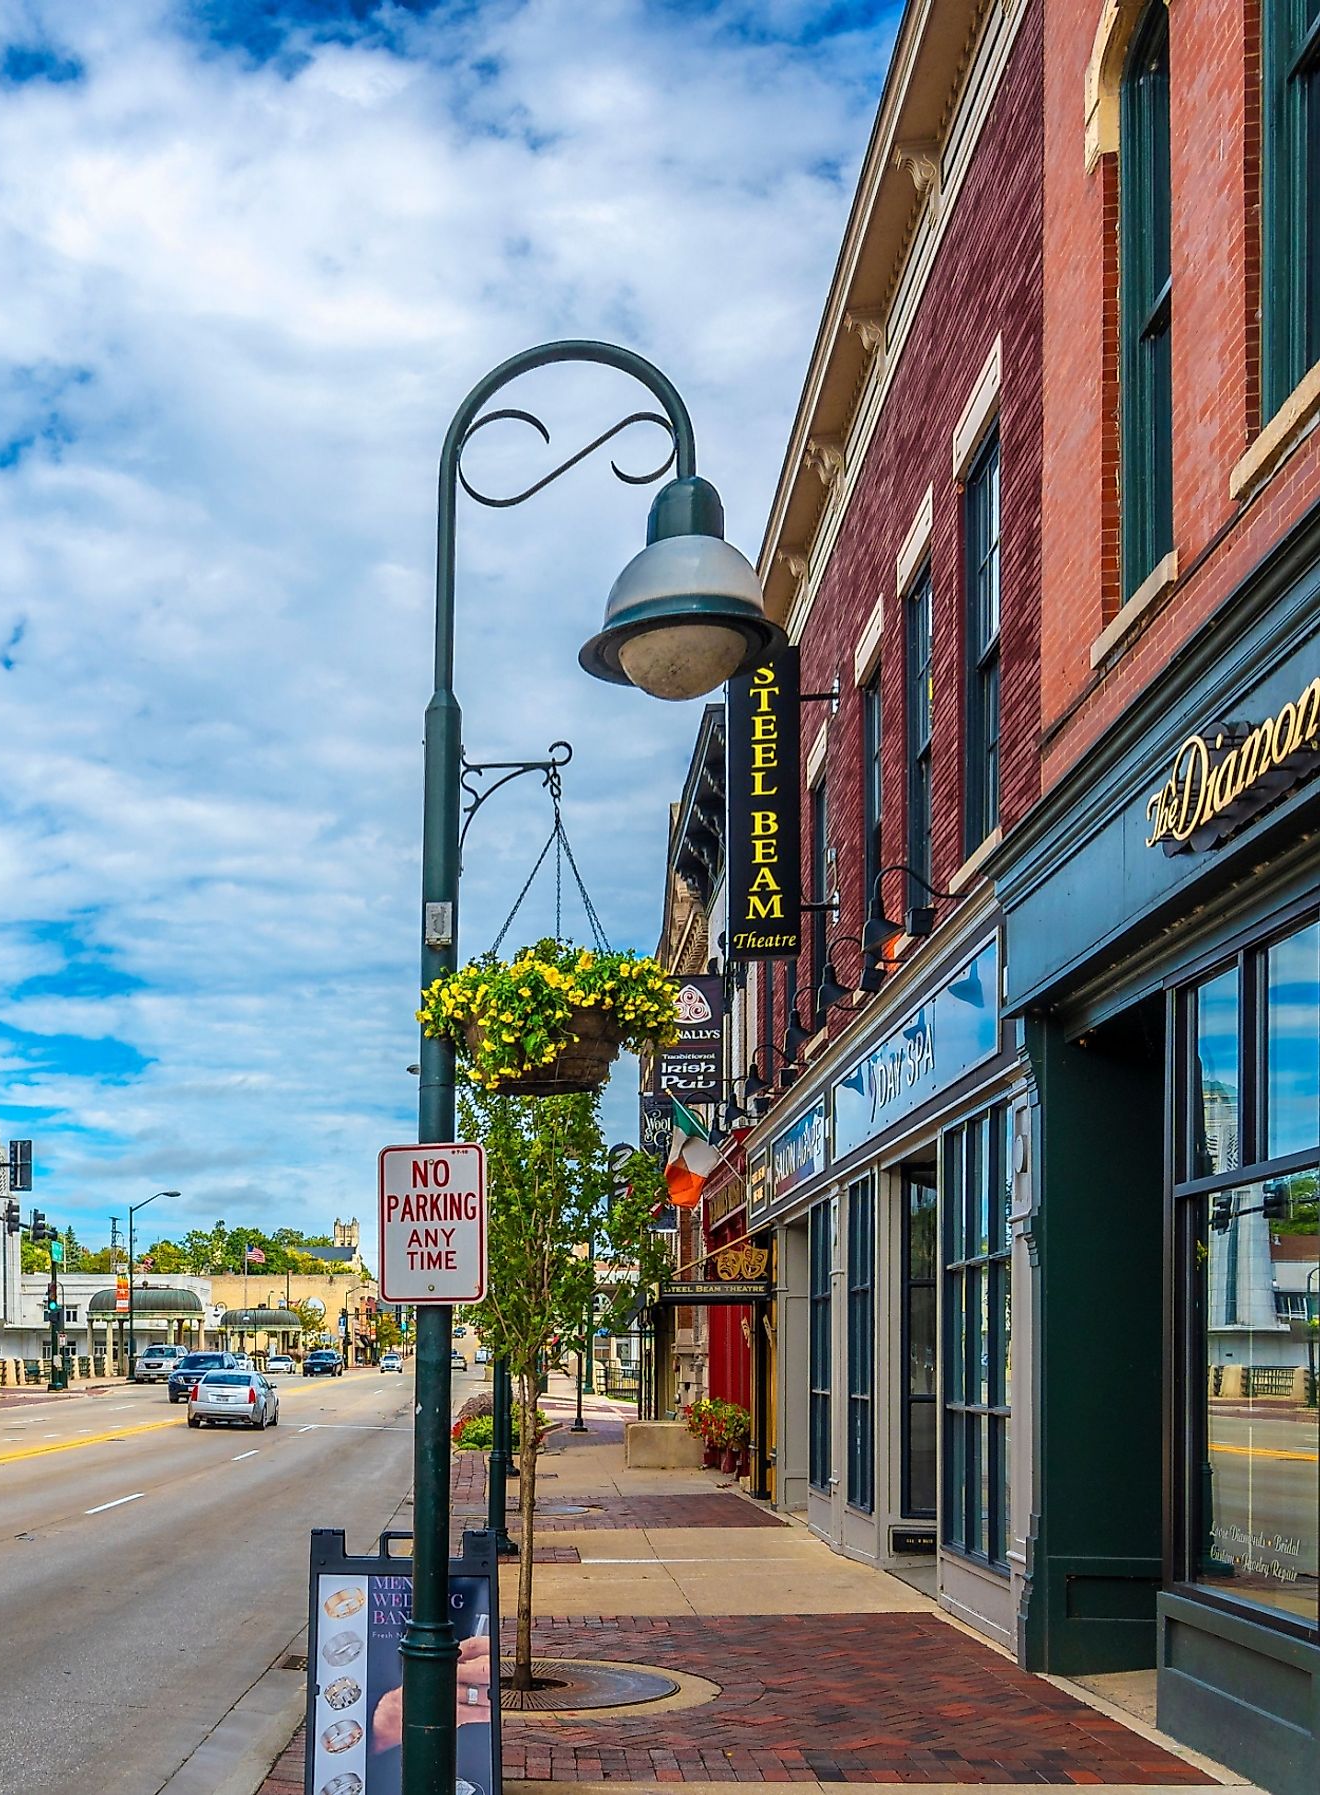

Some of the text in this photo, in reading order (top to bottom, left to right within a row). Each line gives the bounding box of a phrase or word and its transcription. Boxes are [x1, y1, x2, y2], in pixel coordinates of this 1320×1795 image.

[1146, 676, 1320, 848] The Diamon
[745, 662, 784, 920] STEEL BEAM
[733, 931, 797, 950] Theatre
[661, 1061, 716, 1074] Irish
[879, 1023, 935, 1109] DAY SPA
[661, 1074, 716, 1090] Pub
[644, 1108, 671, 1132] Wool
[412, 1159, 451, 1188] NO
[386, 1192, 477, 1223] PARKING
[407, 1228, 456, 1249] ANY
[406, 1250, 458, 1271] TIME
[695, 1285, 721, 1293] BEAM
[724, 1284, 765, 1292] THEATRE
[1209, 1520, 1301, 1557] Loose Diamonds Bridal
[1210, 1543, 1235, 1565] Custom
[1270, 1559, 1298, 1583] Repair
[373, 1576, 414, 1590] MEN
[372, 1631, 394, 1639] Fresh
